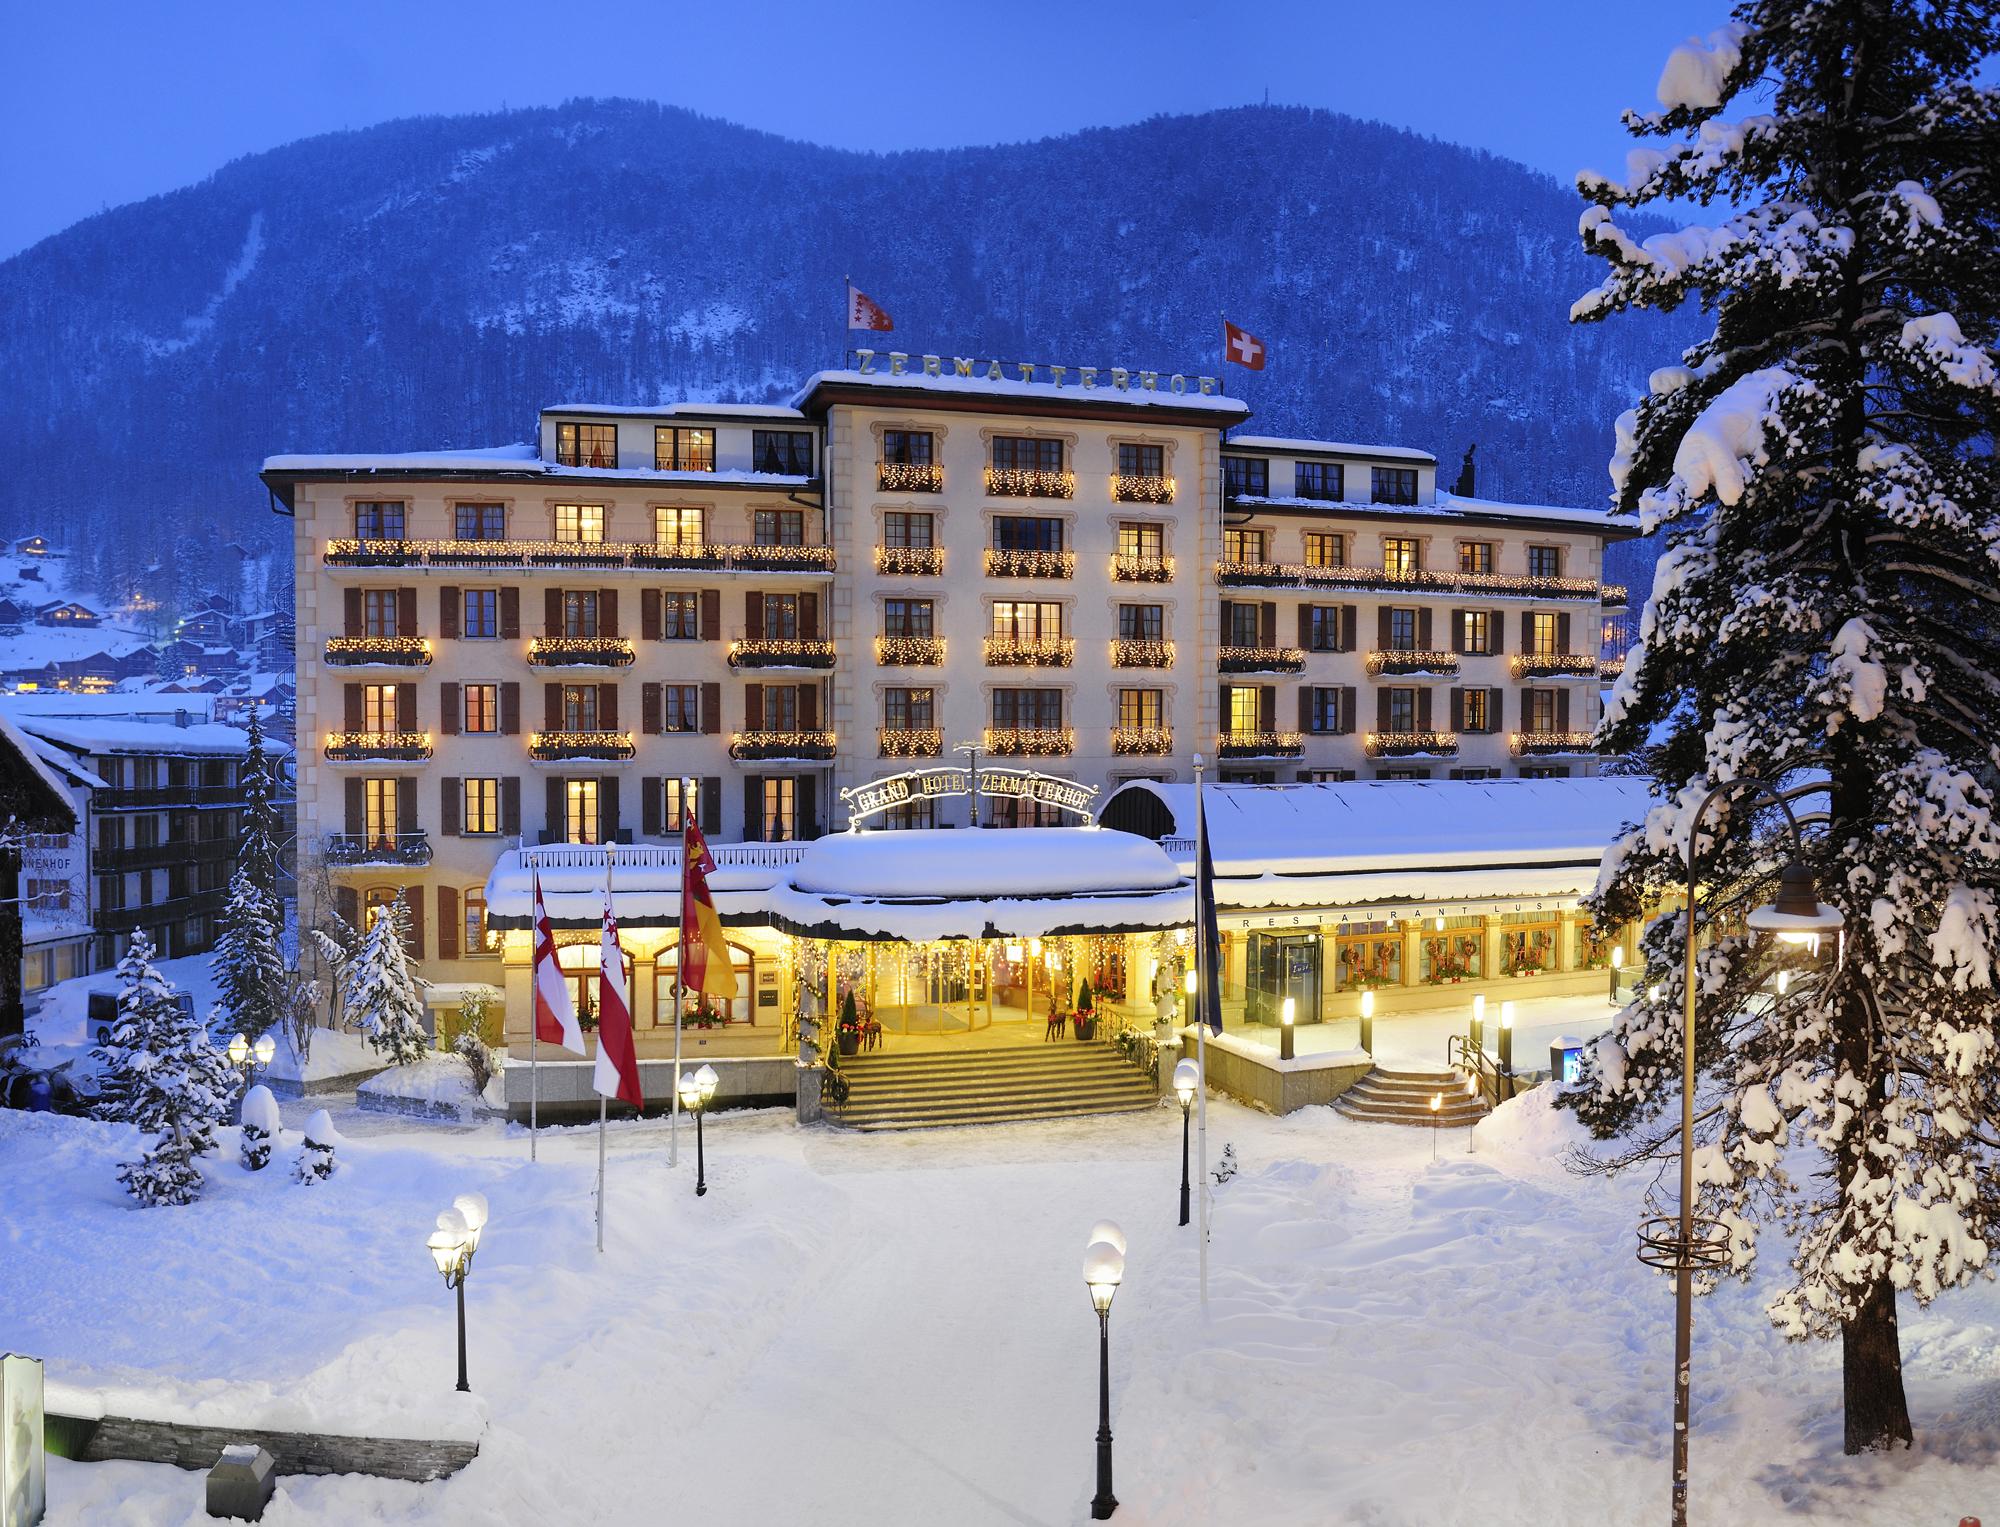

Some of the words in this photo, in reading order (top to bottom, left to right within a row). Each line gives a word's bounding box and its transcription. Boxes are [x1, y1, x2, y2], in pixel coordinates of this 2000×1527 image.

[856, 349, 1216, 396] ZERMATTERHOF
[858, 780, 908, 811] GRAND
[922, 774, 968, 794] HOTEL
[981, 773, 1090, 809] ZERMATTERHOF
[1242, 906, 1469, 928] RESTAURANT
[1494, 901, 1560, 913] LUSI
